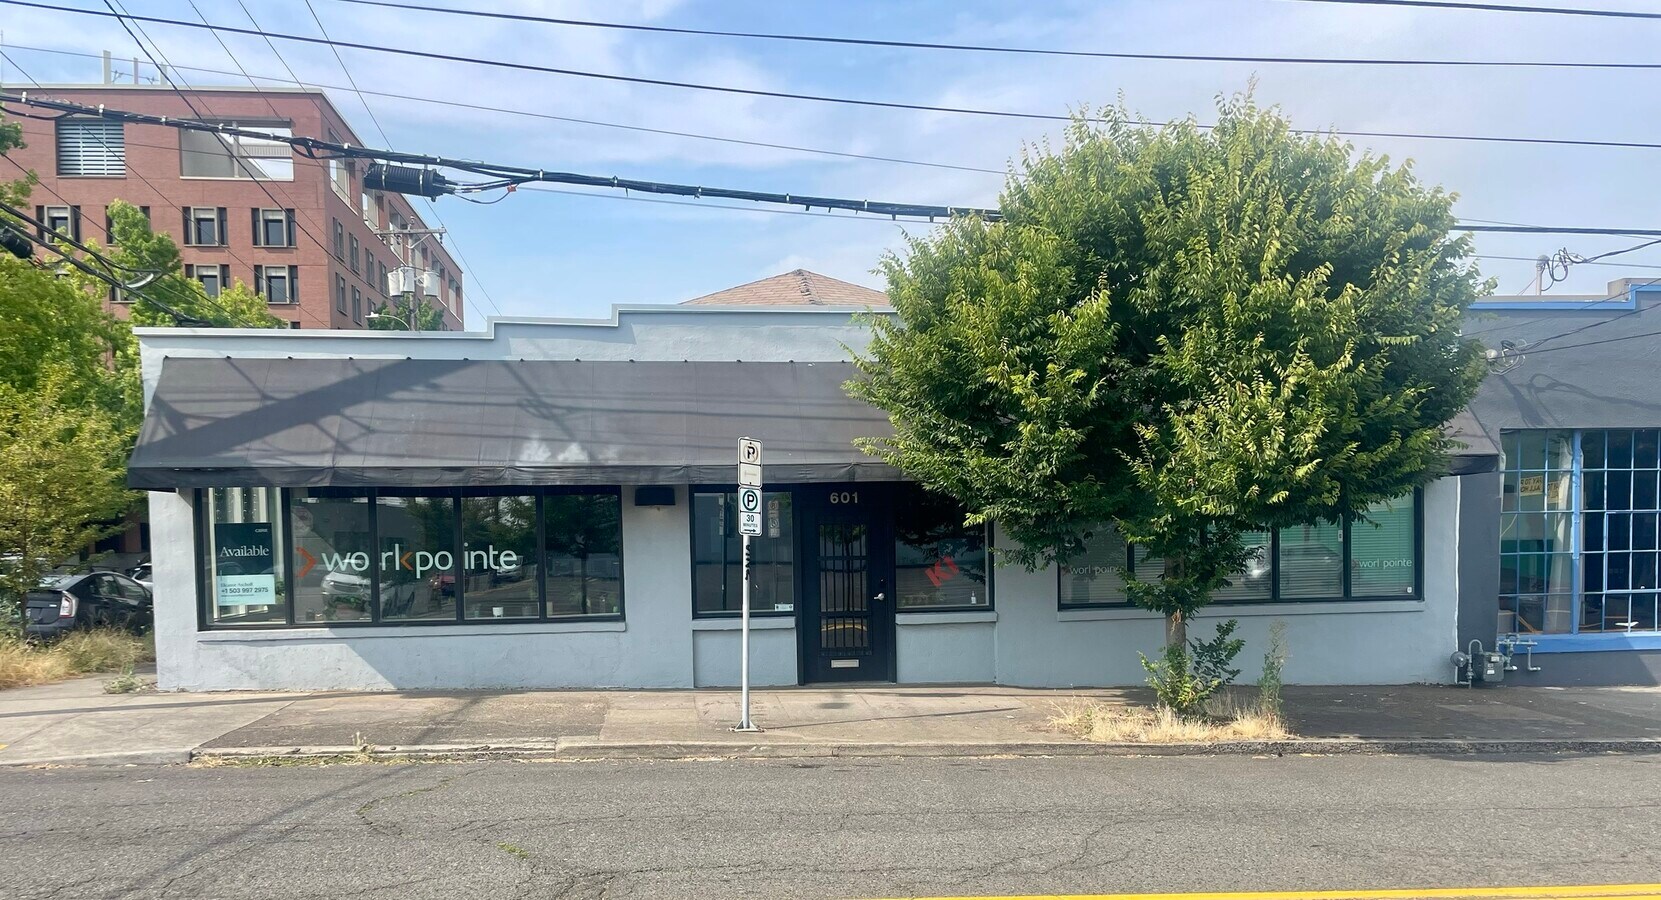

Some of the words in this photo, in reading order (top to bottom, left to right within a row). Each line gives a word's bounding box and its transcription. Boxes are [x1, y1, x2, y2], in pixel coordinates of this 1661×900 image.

[747, 493, 755, 507] P
[830, 491, 858, 504] 601
[746, 514, 755, 522] 30
[220, 545, 270, 557] Available
